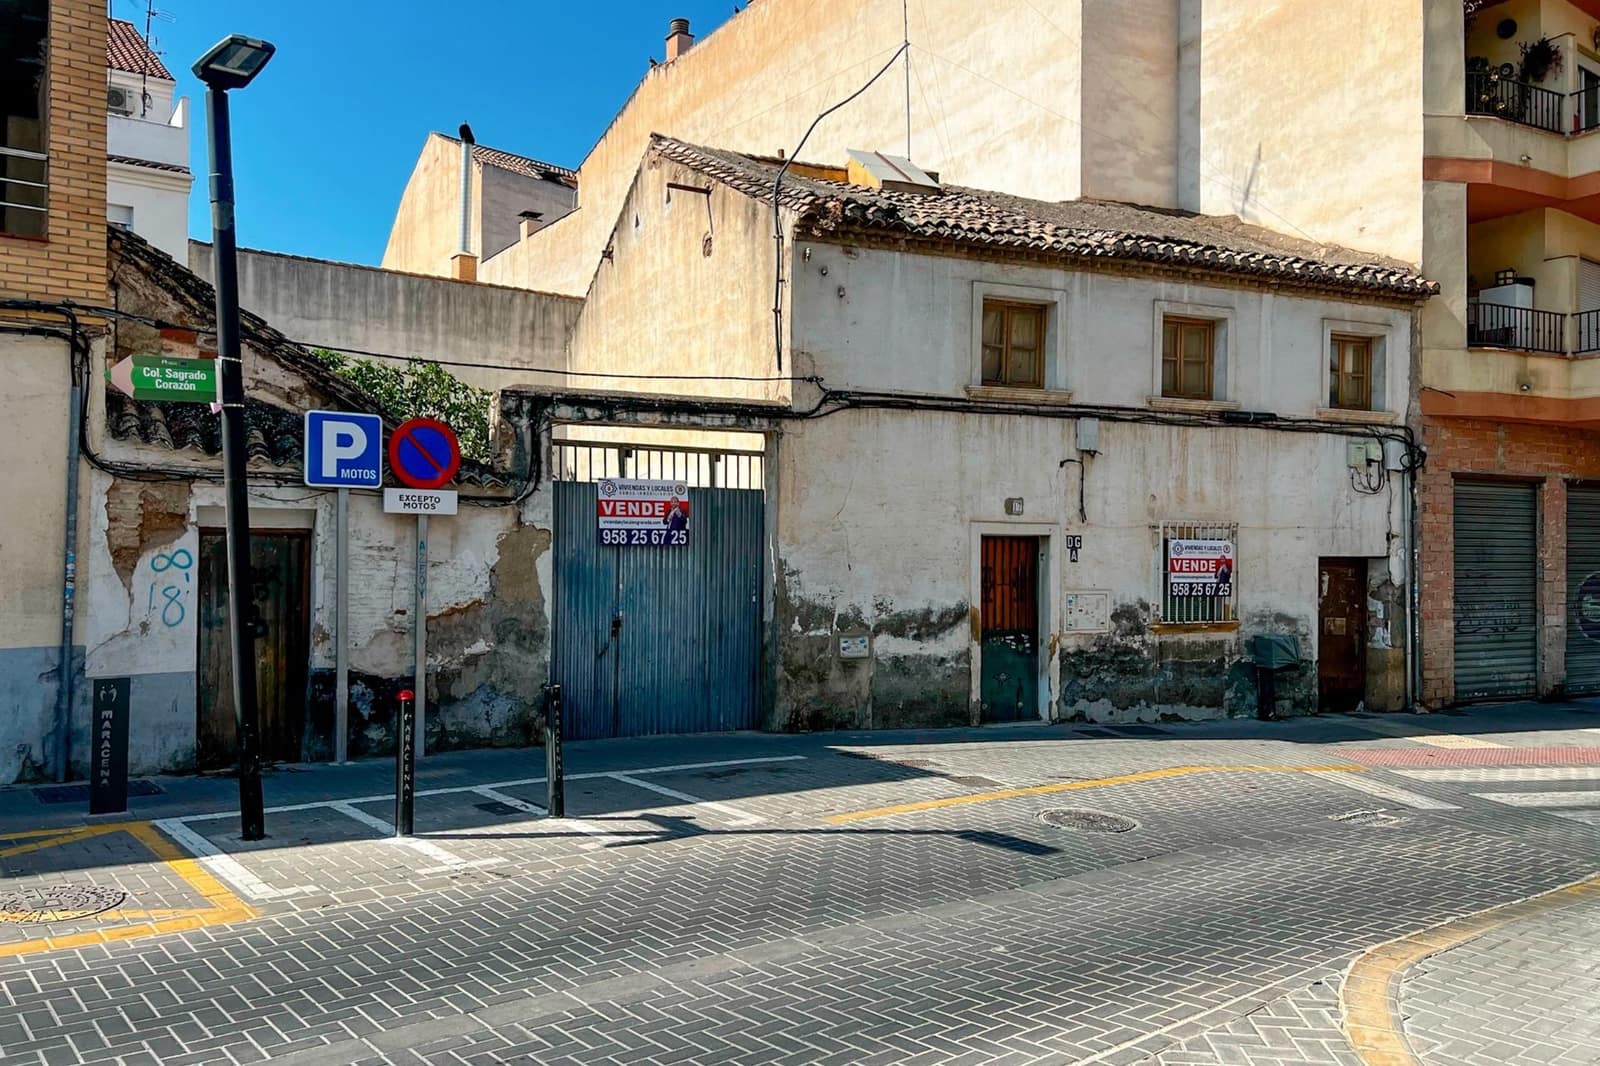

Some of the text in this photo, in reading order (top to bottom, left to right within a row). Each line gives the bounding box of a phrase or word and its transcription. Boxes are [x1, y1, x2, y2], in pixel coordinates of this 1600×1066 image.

[143, 367, 207, 381] Col. Sagrado
[155, 378, 196, 390] Corazón
[321, 420, 367, 478] P
[340, 468, 377, 480] MOTOS
[399, 494, 441, 504] EXCEPTO
[403, 501, 436, 510] MOTOS
[601, 501, 665, 516] VENDE
[602, 530, 687, 545] 958 25 67 25
[1173, 559, 1216, 572] VENDE
[1172, 583, 1230, 596] 958 25 67 25
[100, 710, 113, 786] MARACENA
